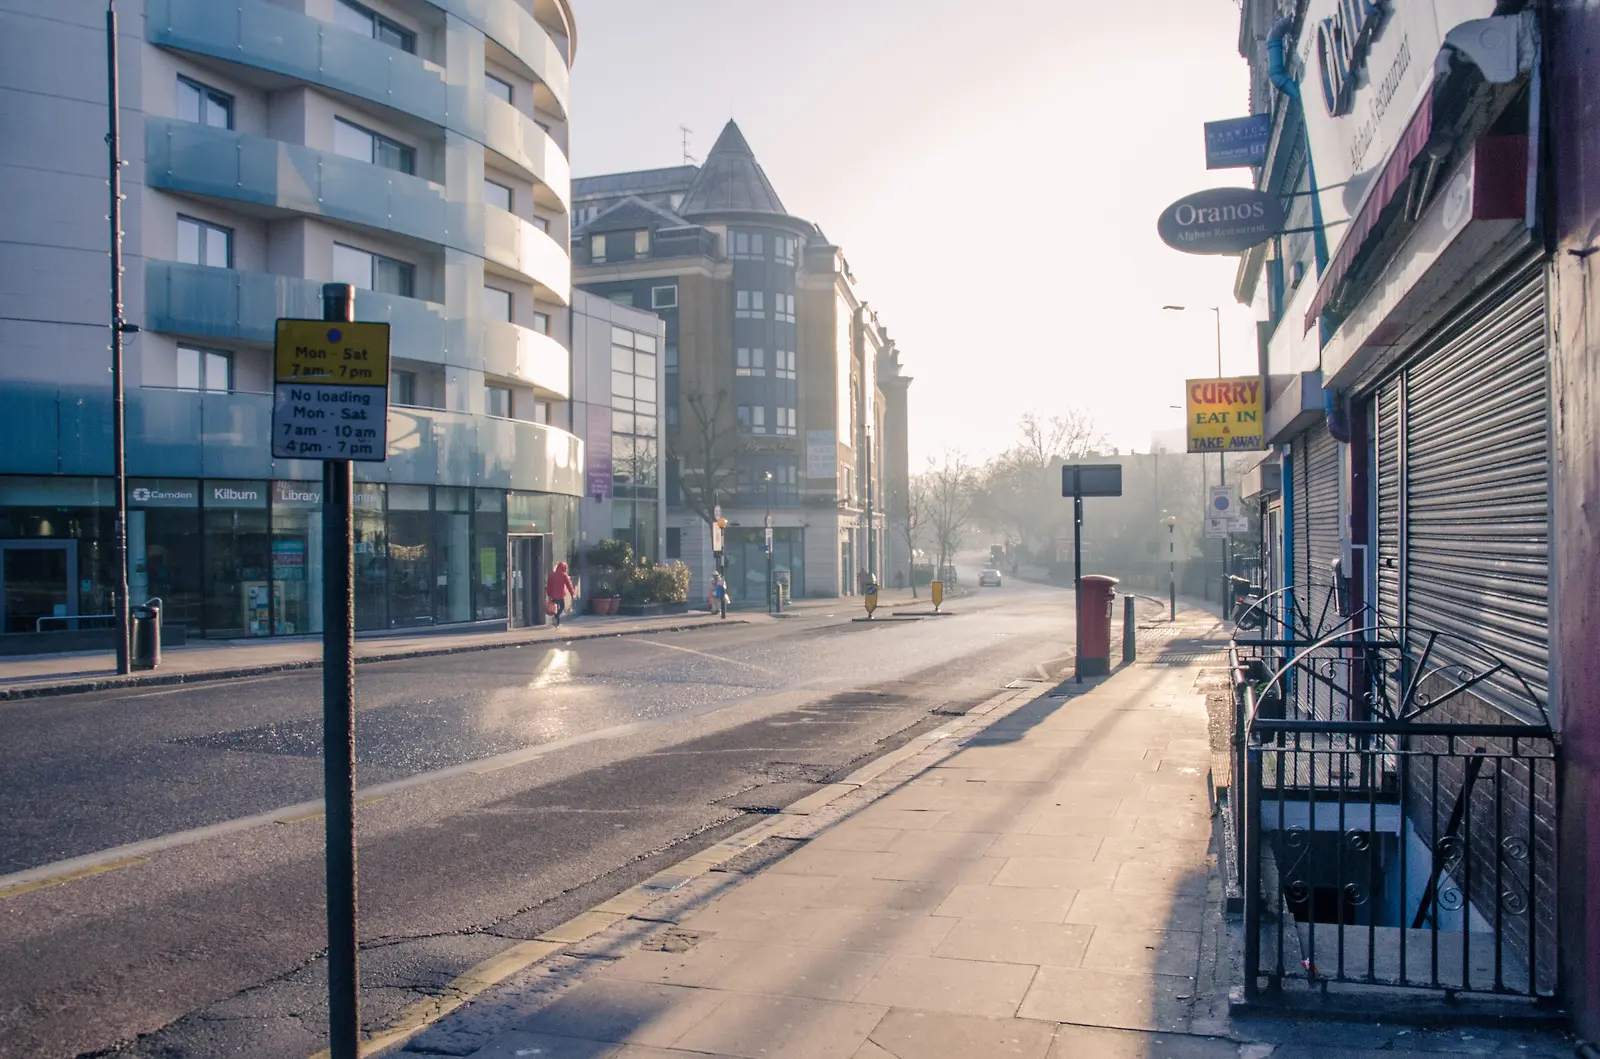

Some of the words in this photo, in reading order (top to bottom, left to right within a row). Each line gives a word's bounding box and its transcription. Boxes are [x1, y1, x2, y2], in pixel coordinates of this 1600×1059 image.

[1369, 32, 1411, 134] Restaurant
[1175, 201, 1264, 226] Oranos
[1176, 230, 1212, 242] Afghan
[1214, 224, 1266, 237] Restaurant
[295, 347, 327, 360] Mon
[342, 348, 368, 361] Sat
[291, 390, 311, 401] No
[317, 390, 371, 406] loading
[1191, 380, 1260, 405] CURRY
[293, 406, 325, 419] Mon
[341, 407, 368, 420] Sat
[1196, 412, 1230, 424] EAT
[1237, 410, 1257, 422] IN
[1222, 426, 1230, 434] &
[1192, 436, 1225, 449] TAKE
[1229, 435, 1262, 448] AWAY
[150, 490, 192, 499] Camden
[214, 488, 257, 500] Kilburn
[281, 490, 320, 503] Library
